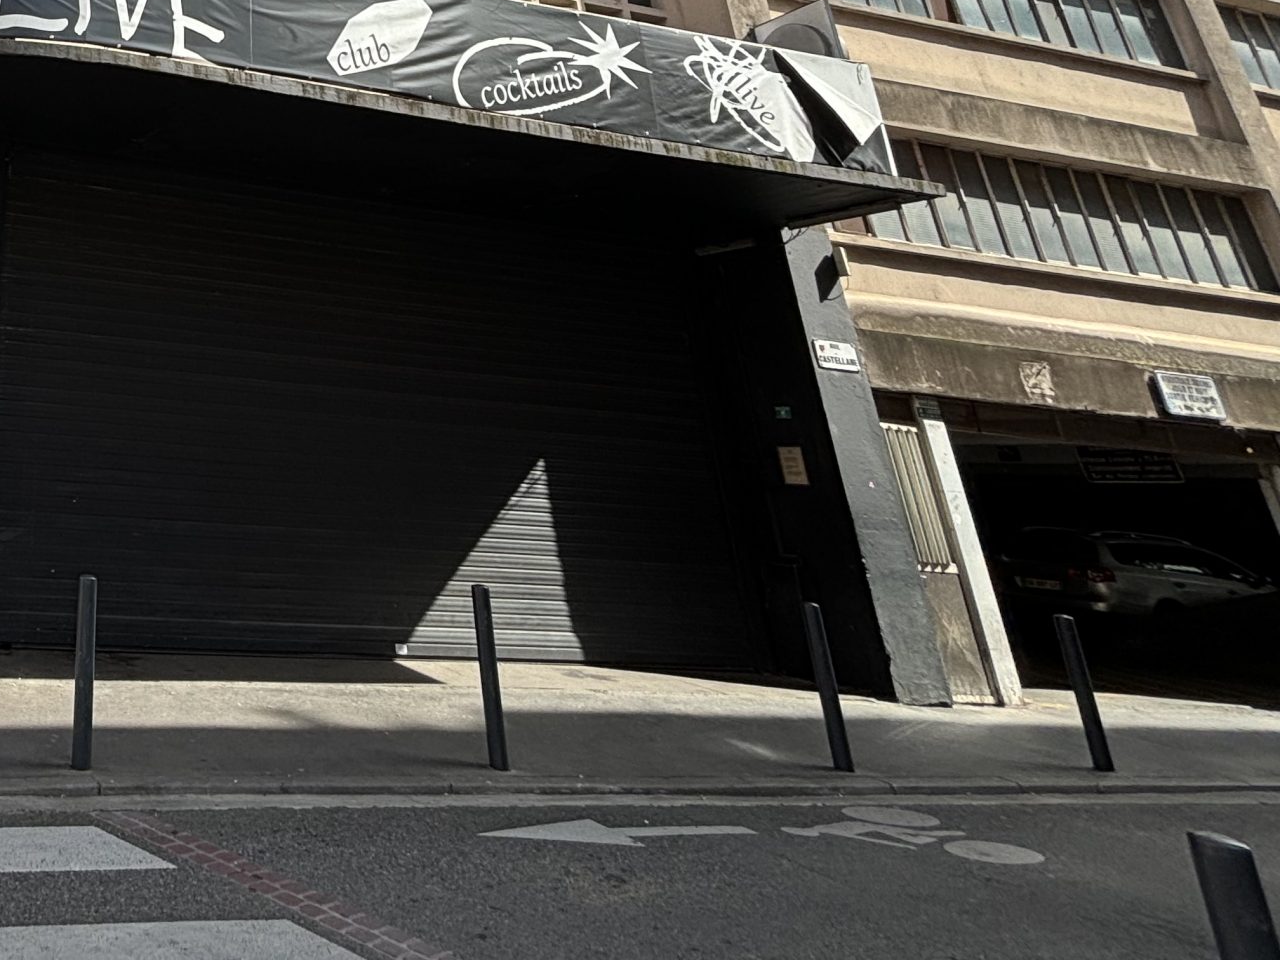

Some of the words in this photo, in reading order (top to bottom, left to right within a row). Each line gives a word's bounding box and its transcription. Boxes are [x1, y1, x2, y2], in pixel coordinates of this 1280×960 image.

[336, 34, 391, 72] club
[480, 61, 583, 108] cocktails
[734, 76, 776, 126] live
